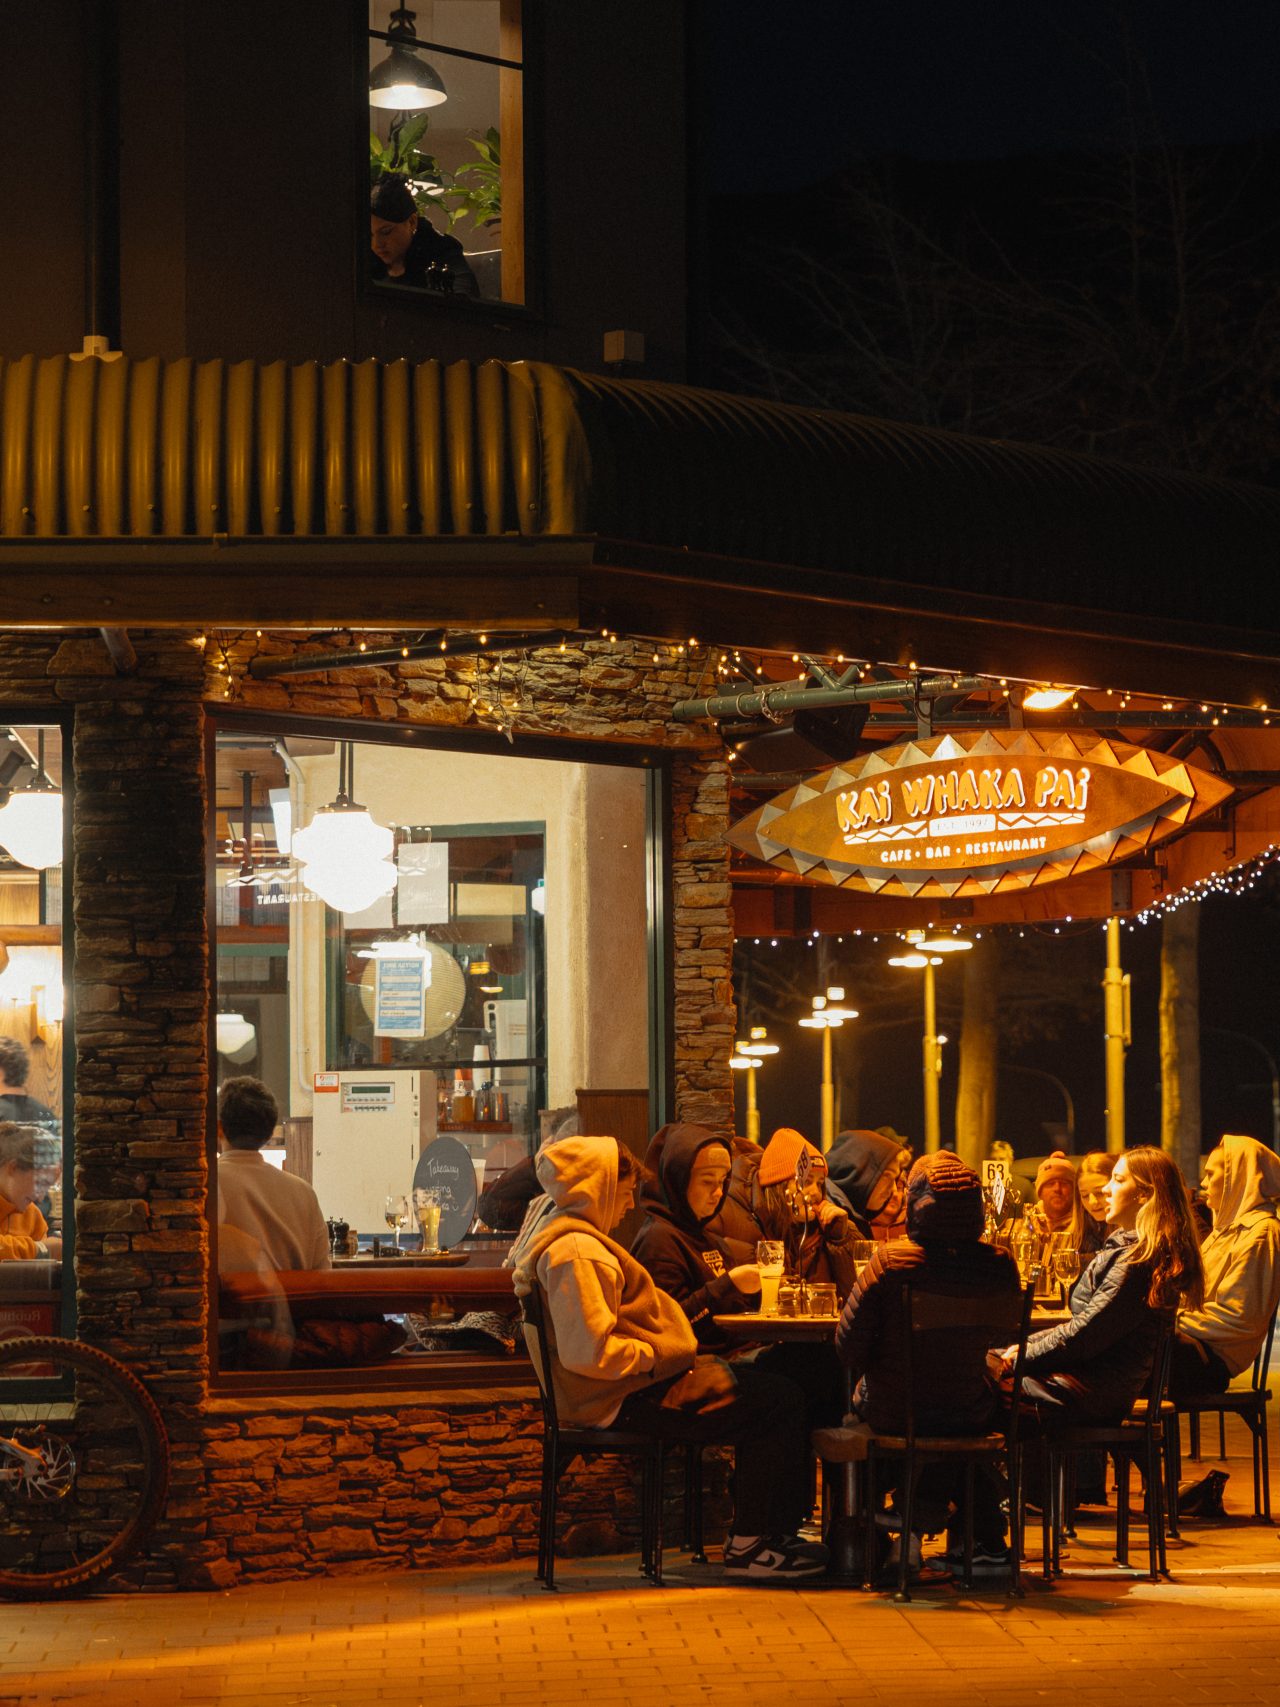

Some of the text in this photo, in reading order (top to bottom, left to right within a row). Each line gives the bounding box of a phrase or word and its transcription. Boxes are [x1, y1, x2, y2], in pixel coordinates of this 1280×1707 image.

[900, 767, 1025, 817] WHAKA
[880, 837, 1047, 862] CAFE BAR RESTAURANT
[427, 1158, 459, 1181] Takeaway
[987, 1163, 1004, 1180] 63
